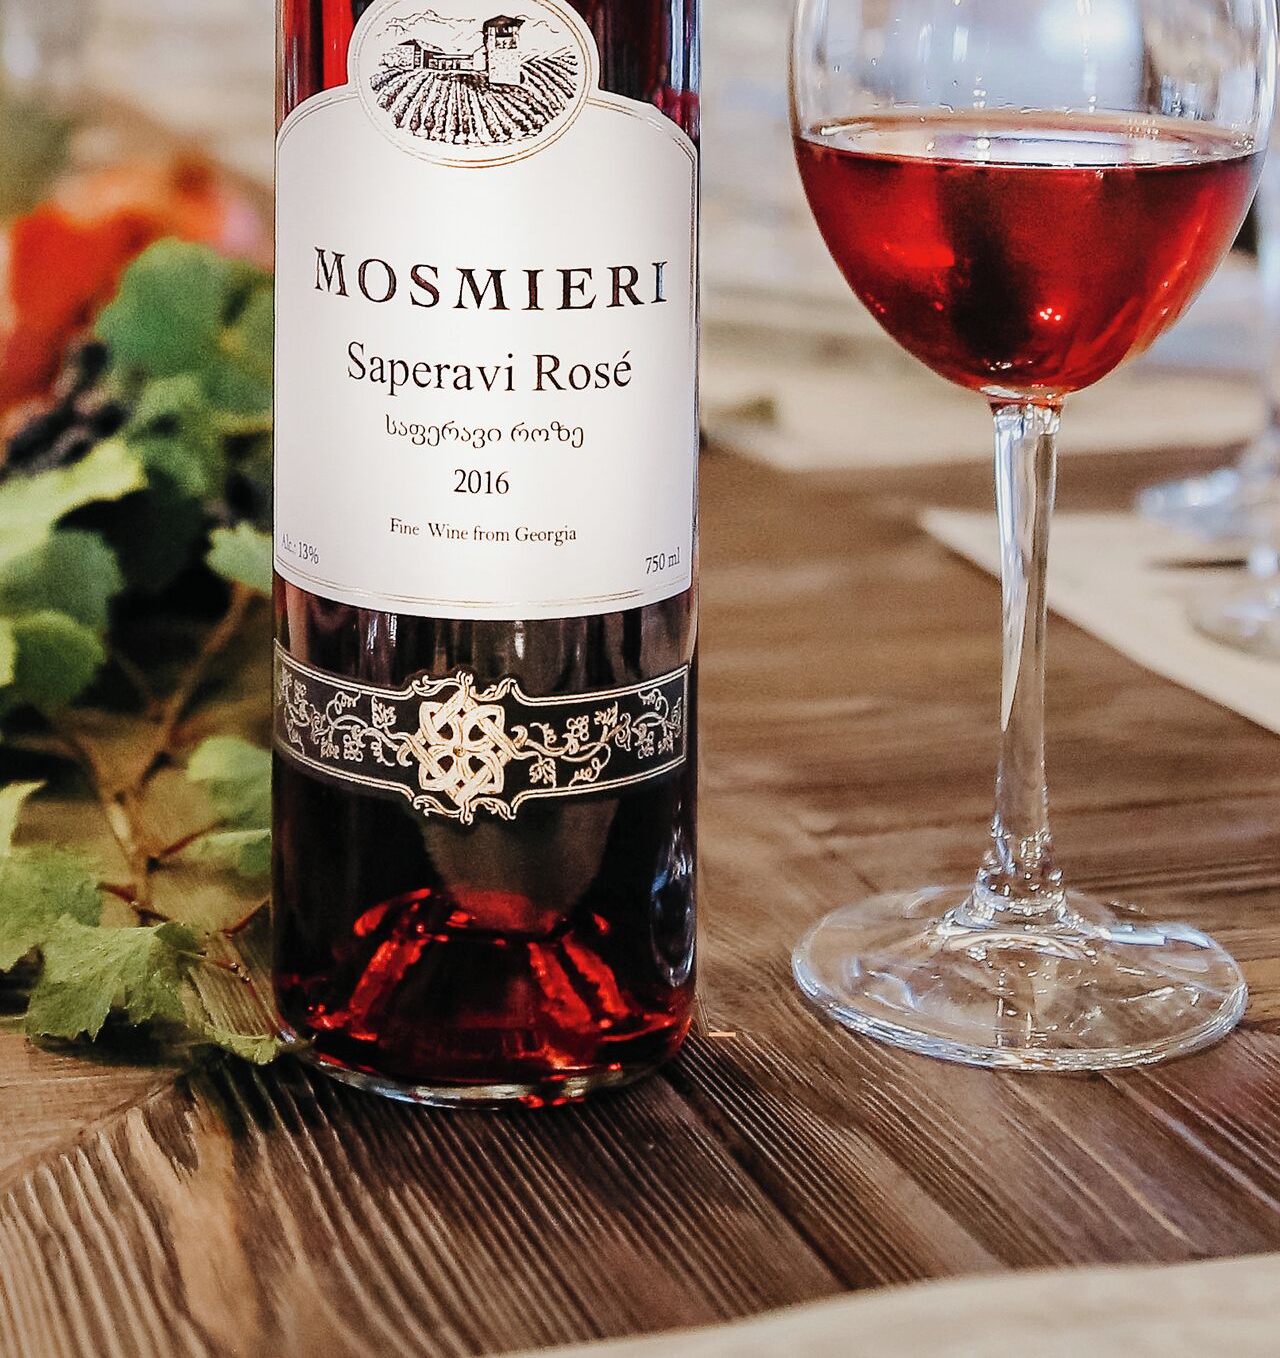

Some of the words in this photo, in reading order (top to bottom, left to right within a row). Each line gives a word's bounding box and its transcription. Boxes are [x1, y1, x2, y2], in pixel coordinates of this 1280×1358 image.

[313, 246, 668, 311] MOSMIERI
[347, 341, 516, 397] Saperavi
[532, 350, 632, 392] Rosé
[385, 413, 502, 449] საფერავი
[510, 421, 585, 449] როზე
[453, 468, 510, 495] 2016
[389, 517, 420, 537] Fine
[427, 522, 469, 541] Wine
[473, 525, 510, 542] from
[514, 524, 577, 547] Georgia
[298, 541, 320, 565] 13%
[645, 552, 666, 575] 750
[667, 546, 681, 568] ml
